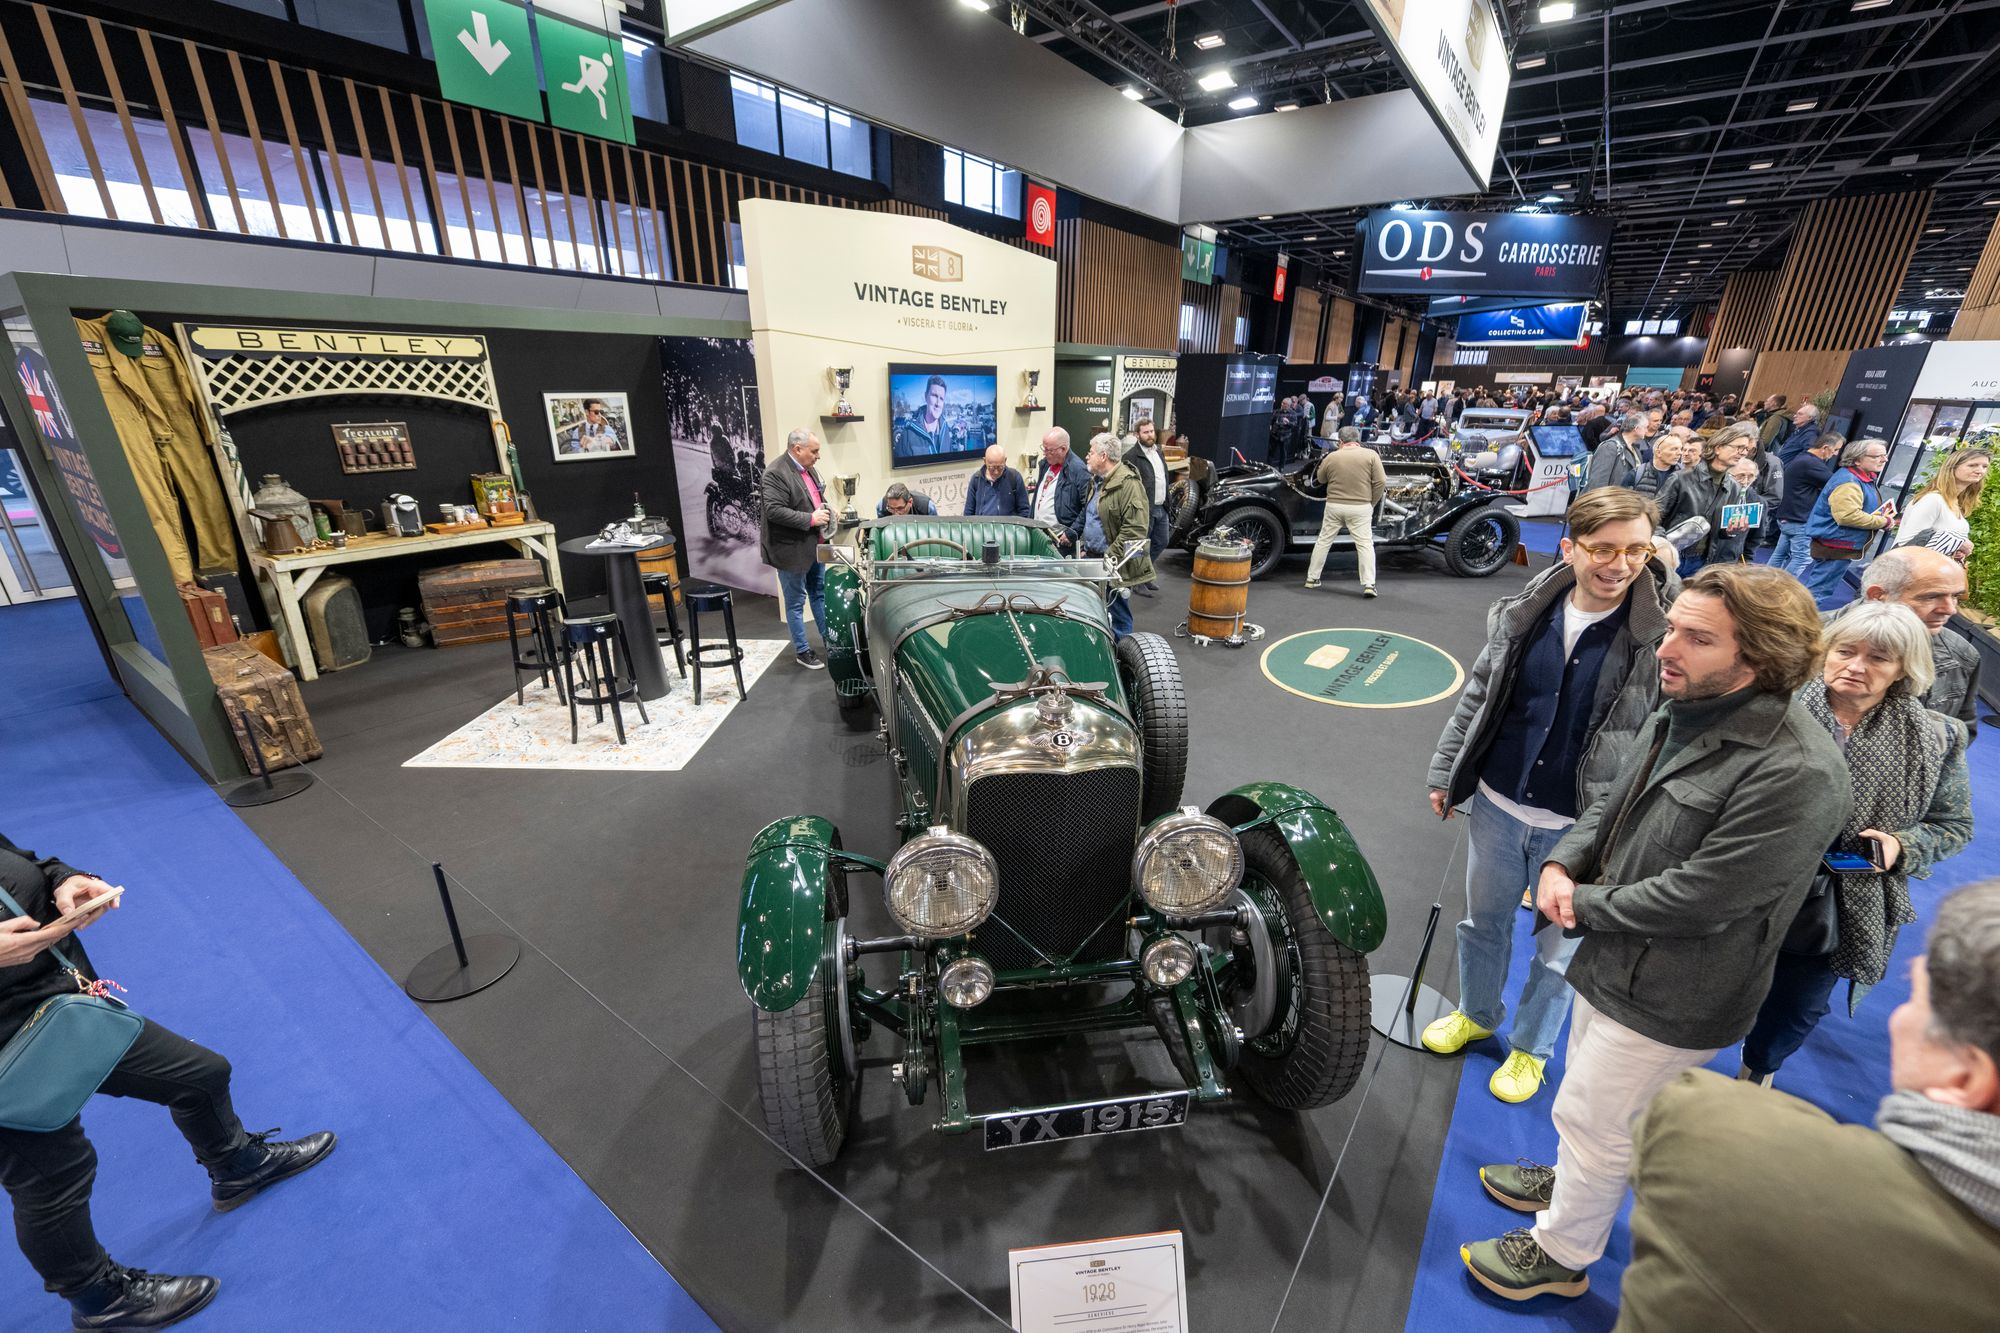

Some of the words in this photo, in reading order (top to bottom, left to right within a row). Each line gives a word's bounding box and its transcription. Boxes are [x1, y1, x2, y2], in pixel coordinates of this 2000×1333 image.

[1438, 28, 1466, 100] VINTAGE
[1464, 83, 1486, 139] BENTLEY
[1378, 219, 1488, 264] ODS
[1498, 242, 1602, 266] CARROSSERIE
[947, 257, 955, 276] 8
[1535, 266, 1557, 277] PARIS
[854, 282, 934, 309] VINTAGE
[941, 294, 1007, 316] BENTLEY
[903, 317, 935, 329] VISCERA
[938, 320, 946, 330] ET
[949, 321, 973, 332] GLORIA
[237, 331, 452, 354] BENTLEY
[1132, 358, 1172, 368] BENTLEY
[1068, 396, 1108, 405] VINTAGE
[342, 426, 399, 438] TECALEMIT
[1319, 664, 1364, 697] VINTAGE
[1356, 634, 1393, 664] BENTLEY
[1001, 1112, 1060, 1144] YX
[1082, 1099, 1174, 1133] 1915
[1082, 1281, 1116, 1303] 1928
